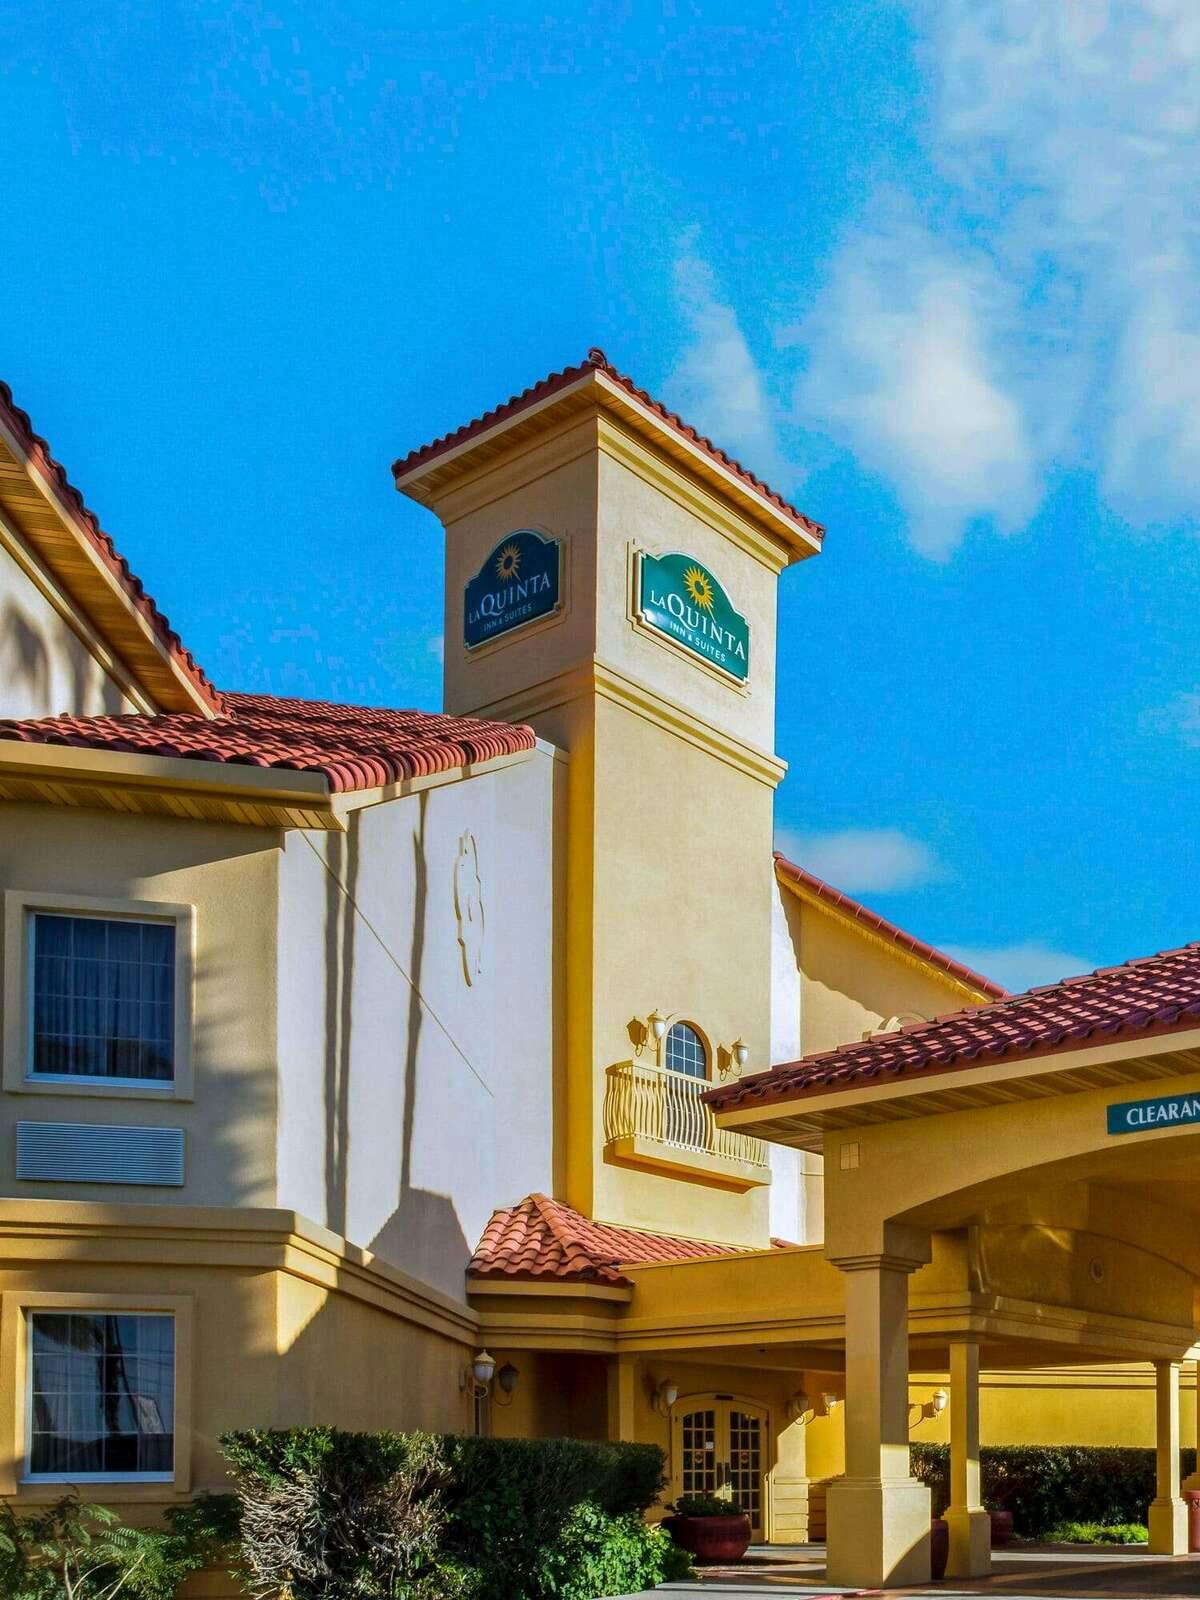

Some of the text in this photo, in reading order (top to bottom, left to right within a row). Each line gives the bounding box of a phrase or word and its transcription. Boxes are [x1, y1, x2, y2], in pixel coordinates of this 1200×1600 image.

[481, 572, 550, 616] QUINTA
[483, 620, 497, 632] INN
[504, 603, 532, 622] SUITES
[650, 590, 745, 660] LA QUINTA
[670, 621, 686, 637] INN
[694, 637, 726, 662] SUITES
